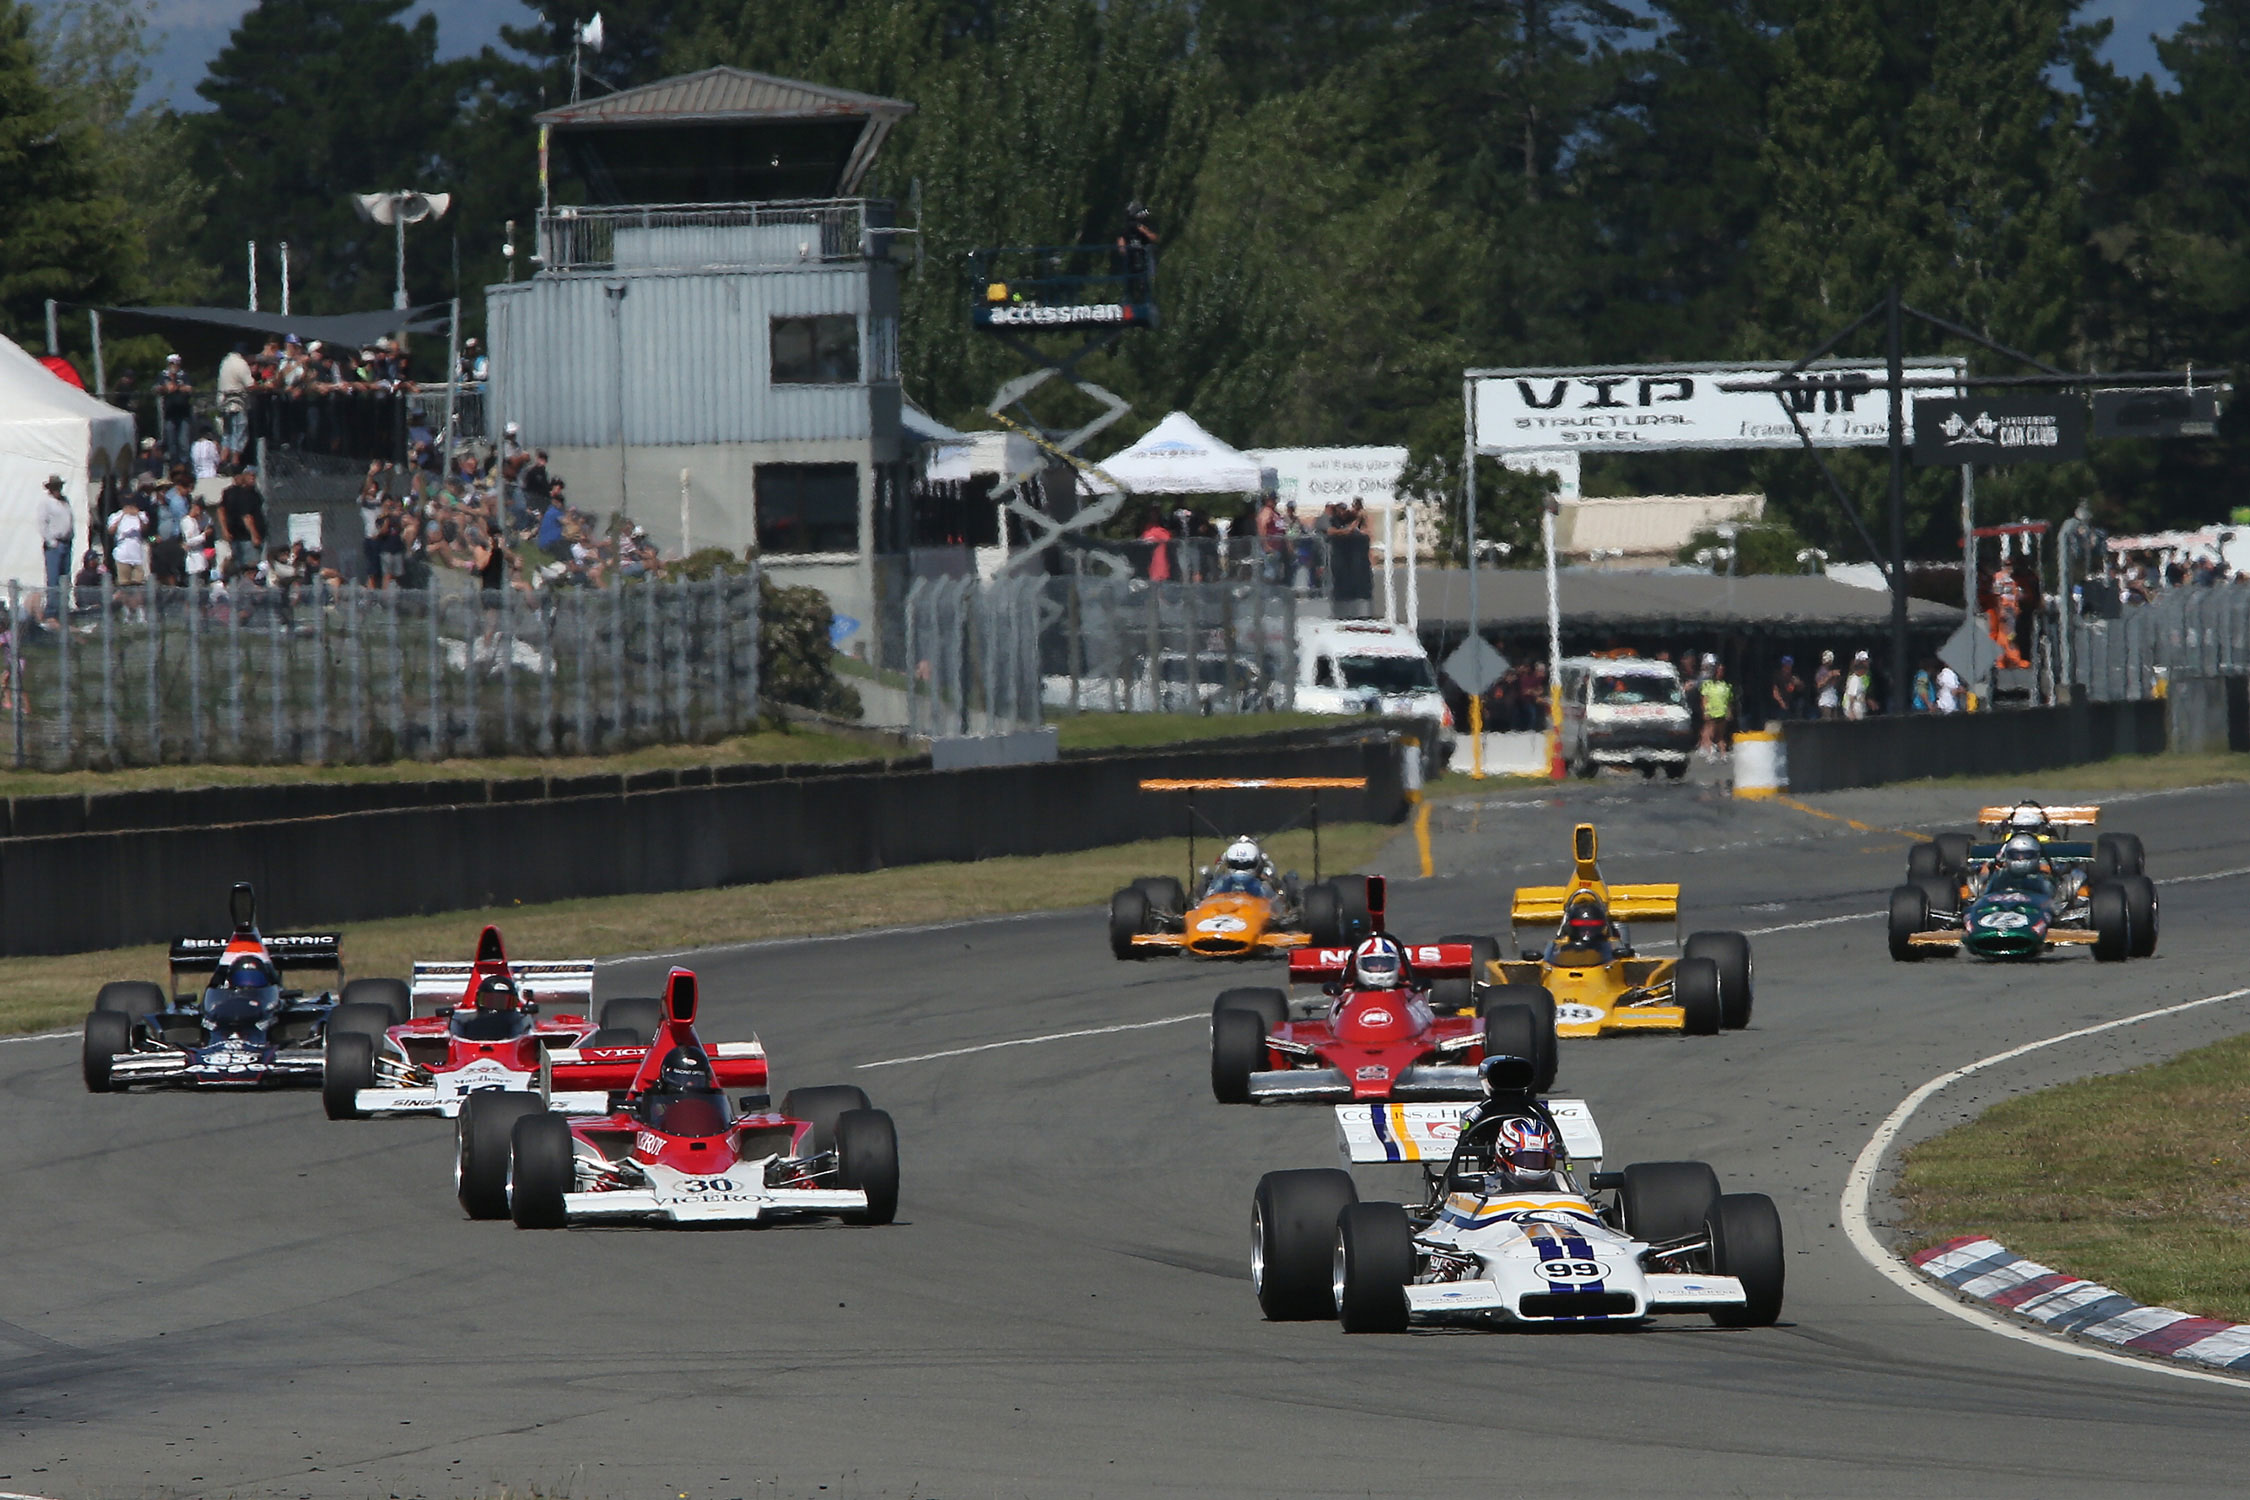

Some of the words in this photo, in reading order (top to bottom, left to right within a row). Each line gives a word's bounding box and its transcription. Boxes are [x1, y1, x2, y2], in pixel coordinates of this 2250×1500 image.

[989, 303, 1124, 325] accessman
[1514, 377, 1695, 410] VIP
[1514, 414, 1695, 428] STRUCTURAL
[1561, 431, 1646, 443] STEEL
[2000, 426, 2024, 447] CAR
[261, 936, 334, 946] ECTRIC
[453, 1074, 513, 1084] Marlboro
[684, 1179, 732, 1193] 30
[651, 1194, 777, 1206] VICEROY
[1545, 1263, 1599, 1278] 99
